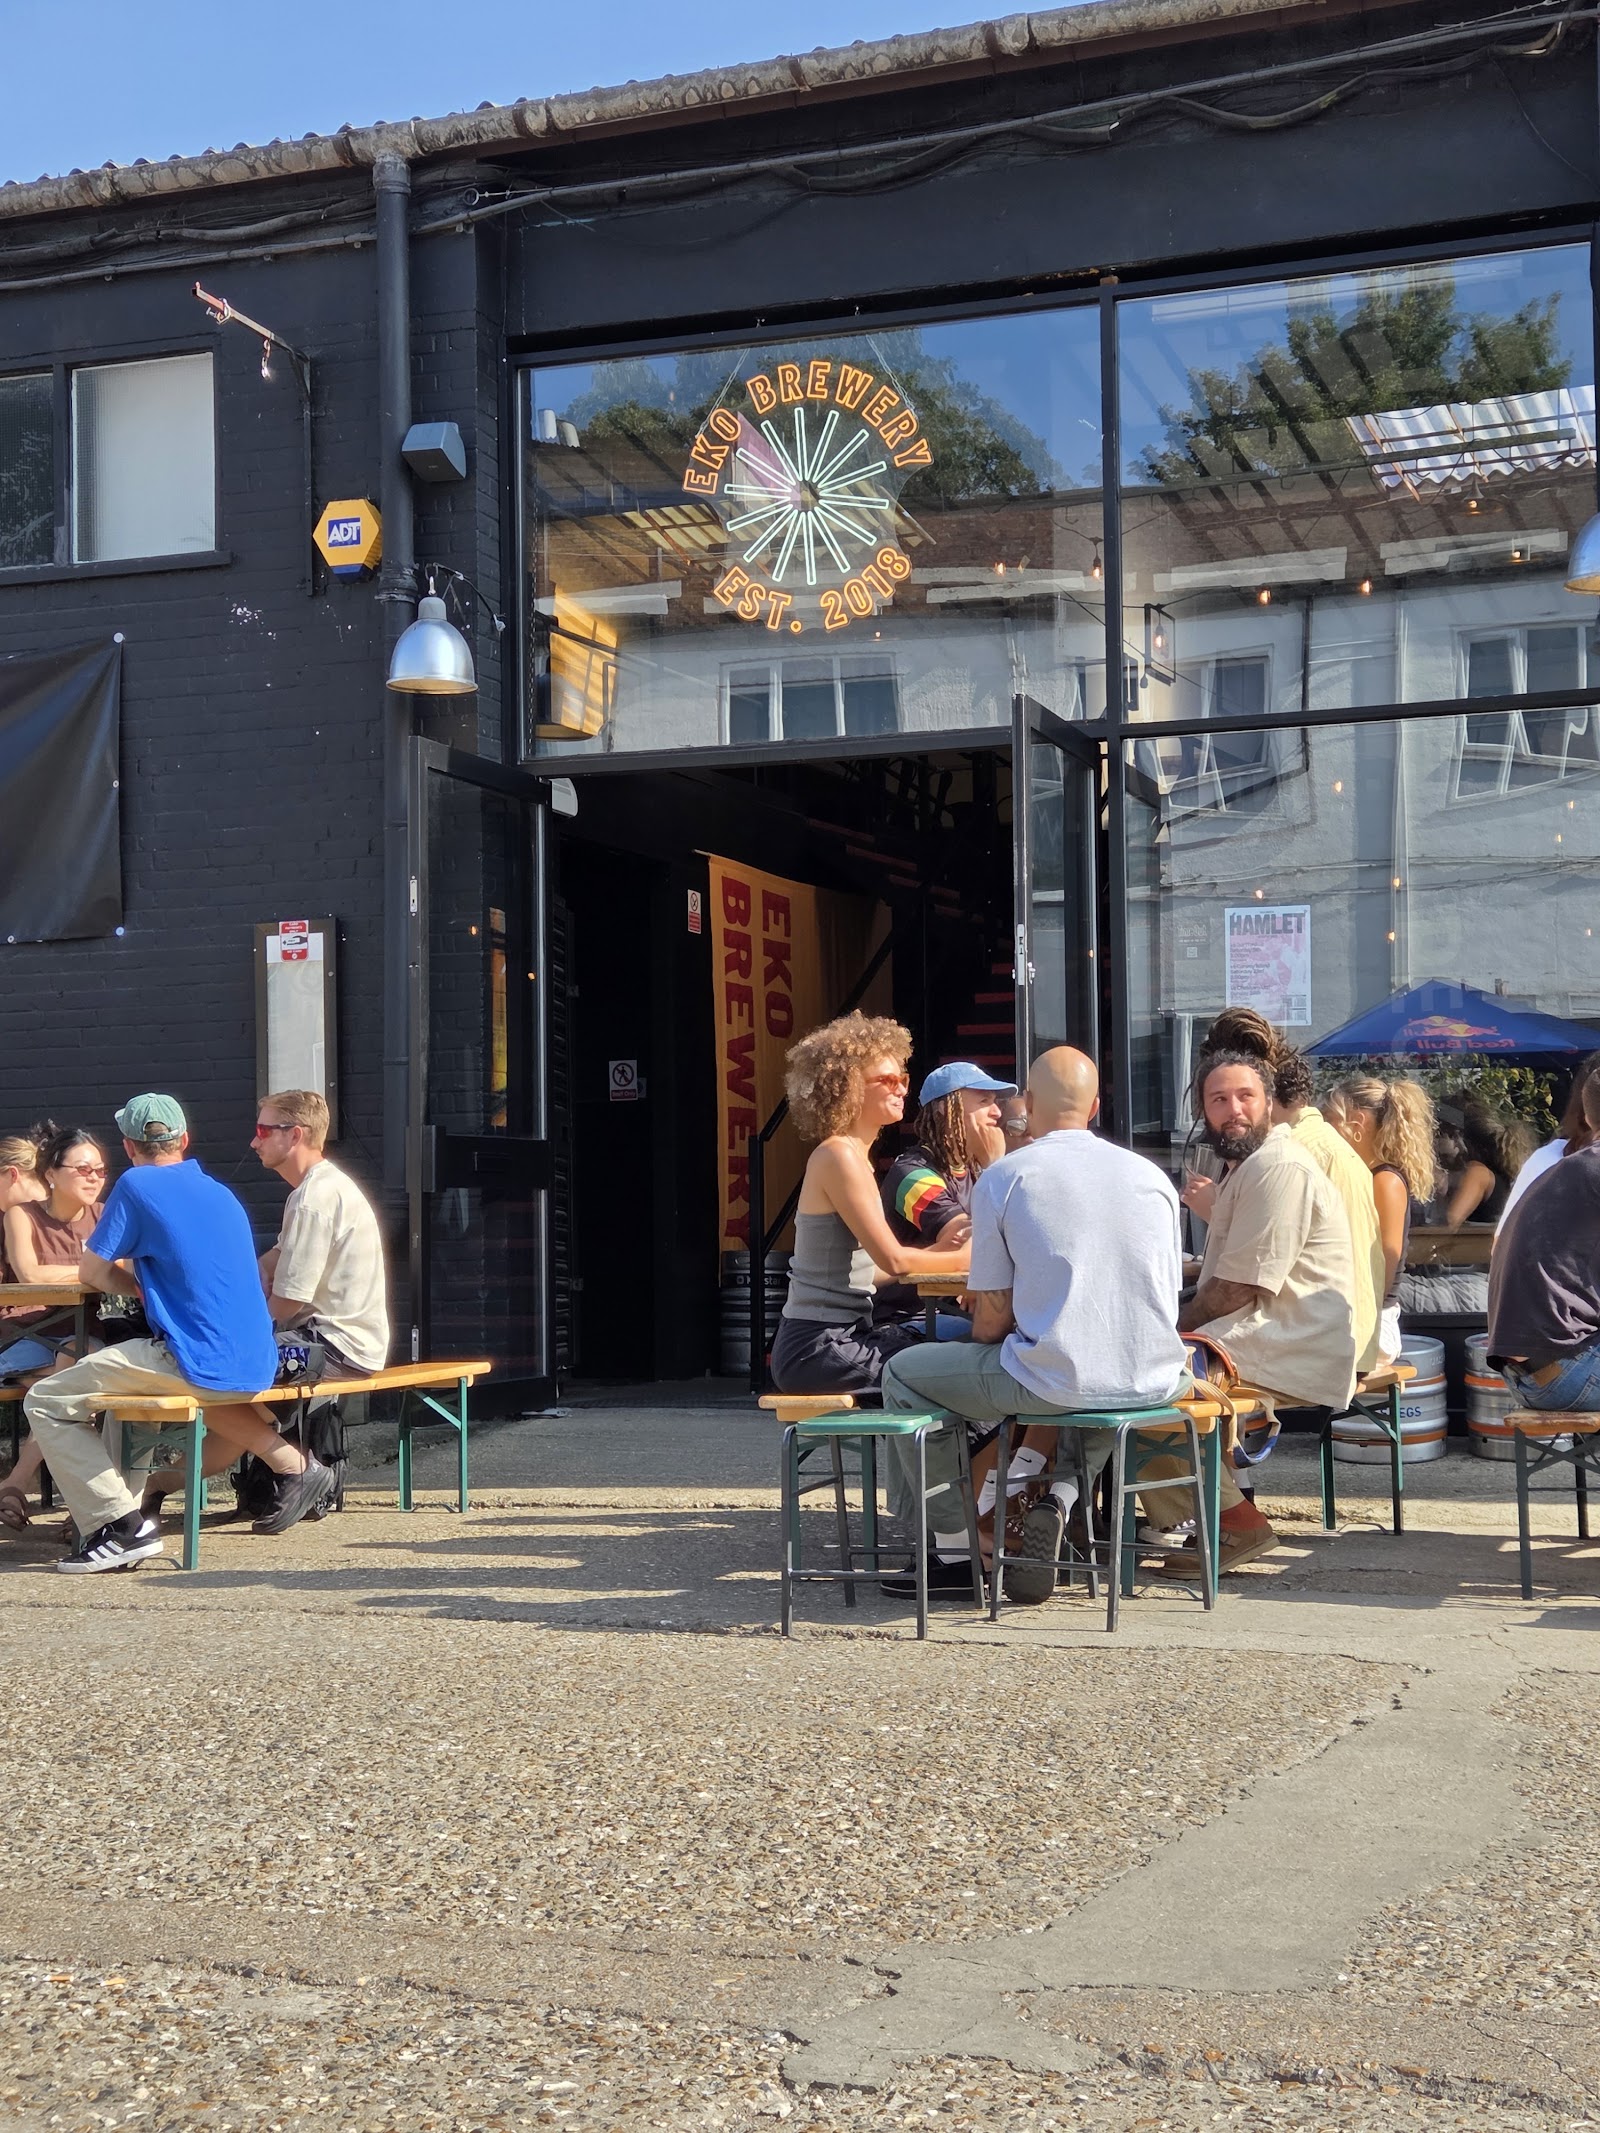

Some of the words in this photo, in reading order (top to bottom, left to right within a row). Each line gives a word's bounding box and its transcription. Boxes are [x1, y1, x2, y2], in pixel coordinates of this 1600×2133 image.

[682, 408, 742, 494] EKO
[746, 360, 934, 467] BREWERY
[328, 521, 361, 544] ADT
[713, 565, 802, 633] EST.
[820, 547, 912, 631] 2018
[761, 888, 794, 1039] EKO
[1229, 913, 1305, 936] HAMLET
[721, 875, 758, 1250] BREWERY
